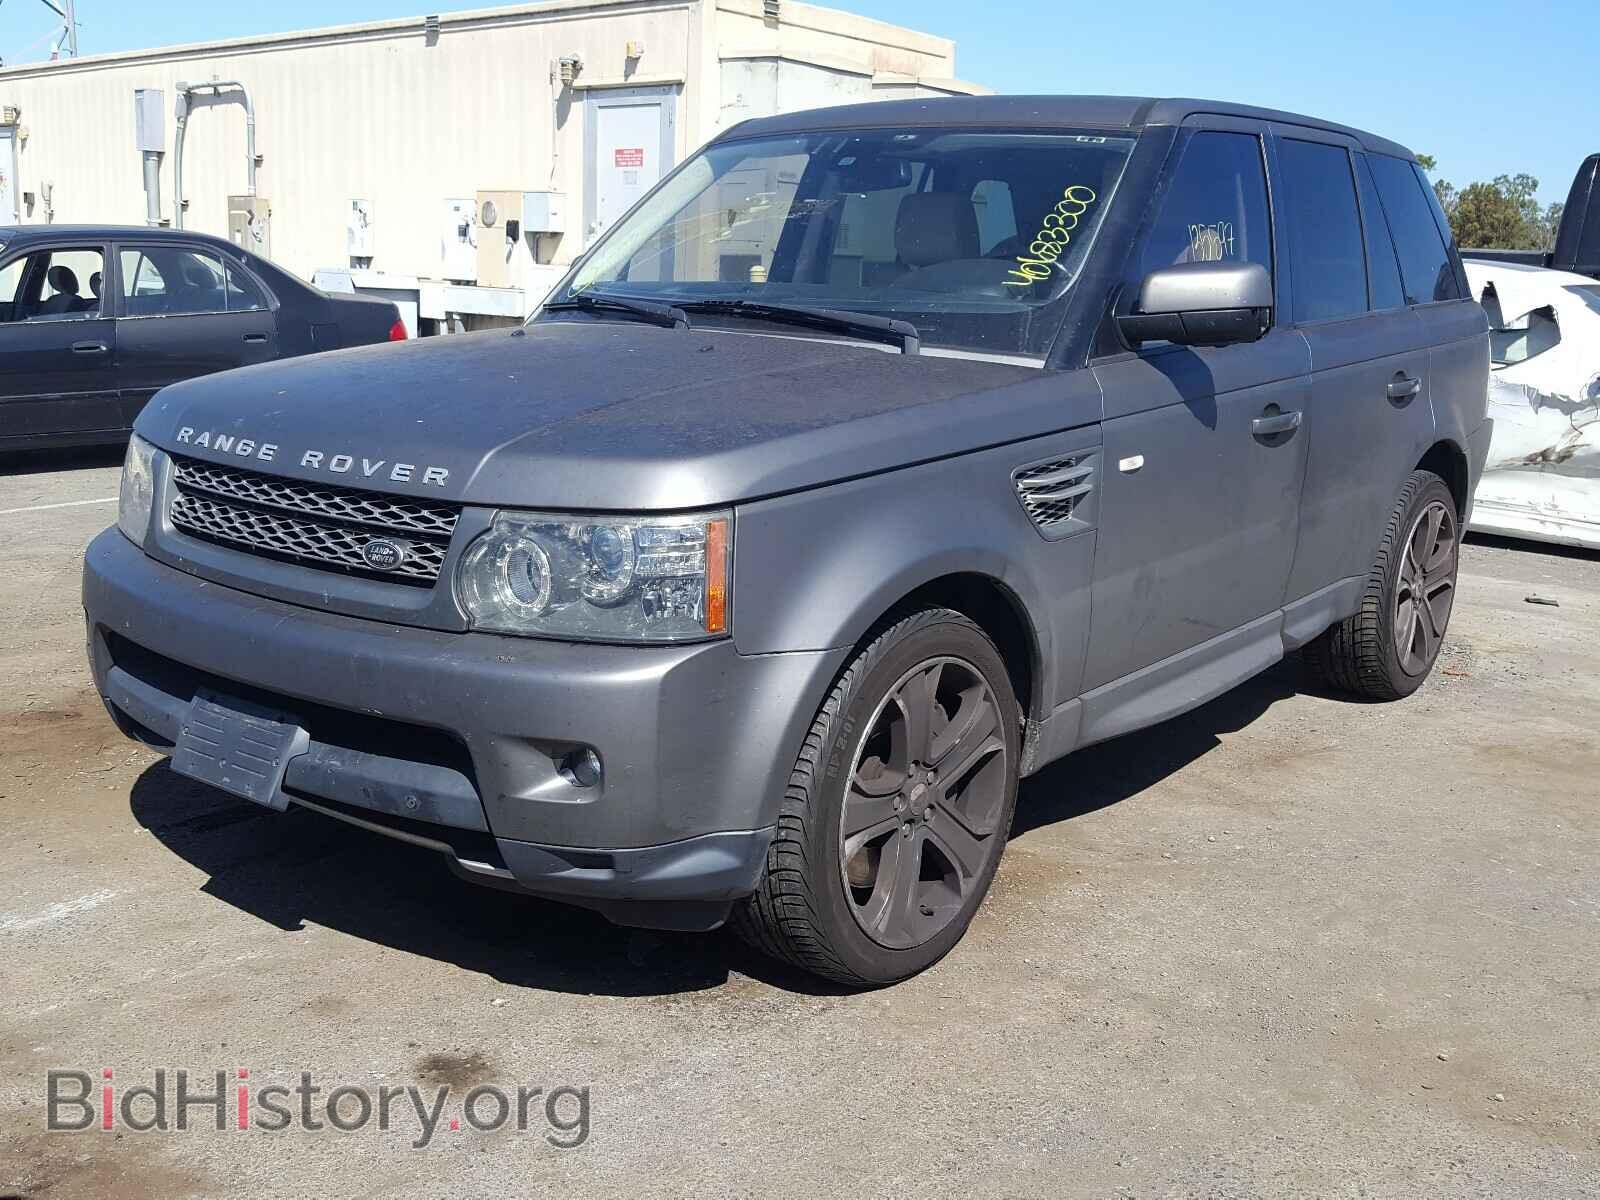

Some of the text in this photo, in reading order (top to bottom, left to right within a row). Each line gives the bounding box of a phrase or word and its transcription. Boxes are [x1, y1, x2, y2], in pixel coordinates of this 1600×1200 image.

[1001, 186, 1095, 286] 40683300
[176, 426, 450, 487] RANGE ROVER
[371, 545, 390, 554] LAND
[371, 554, 394, 564] ROVER
